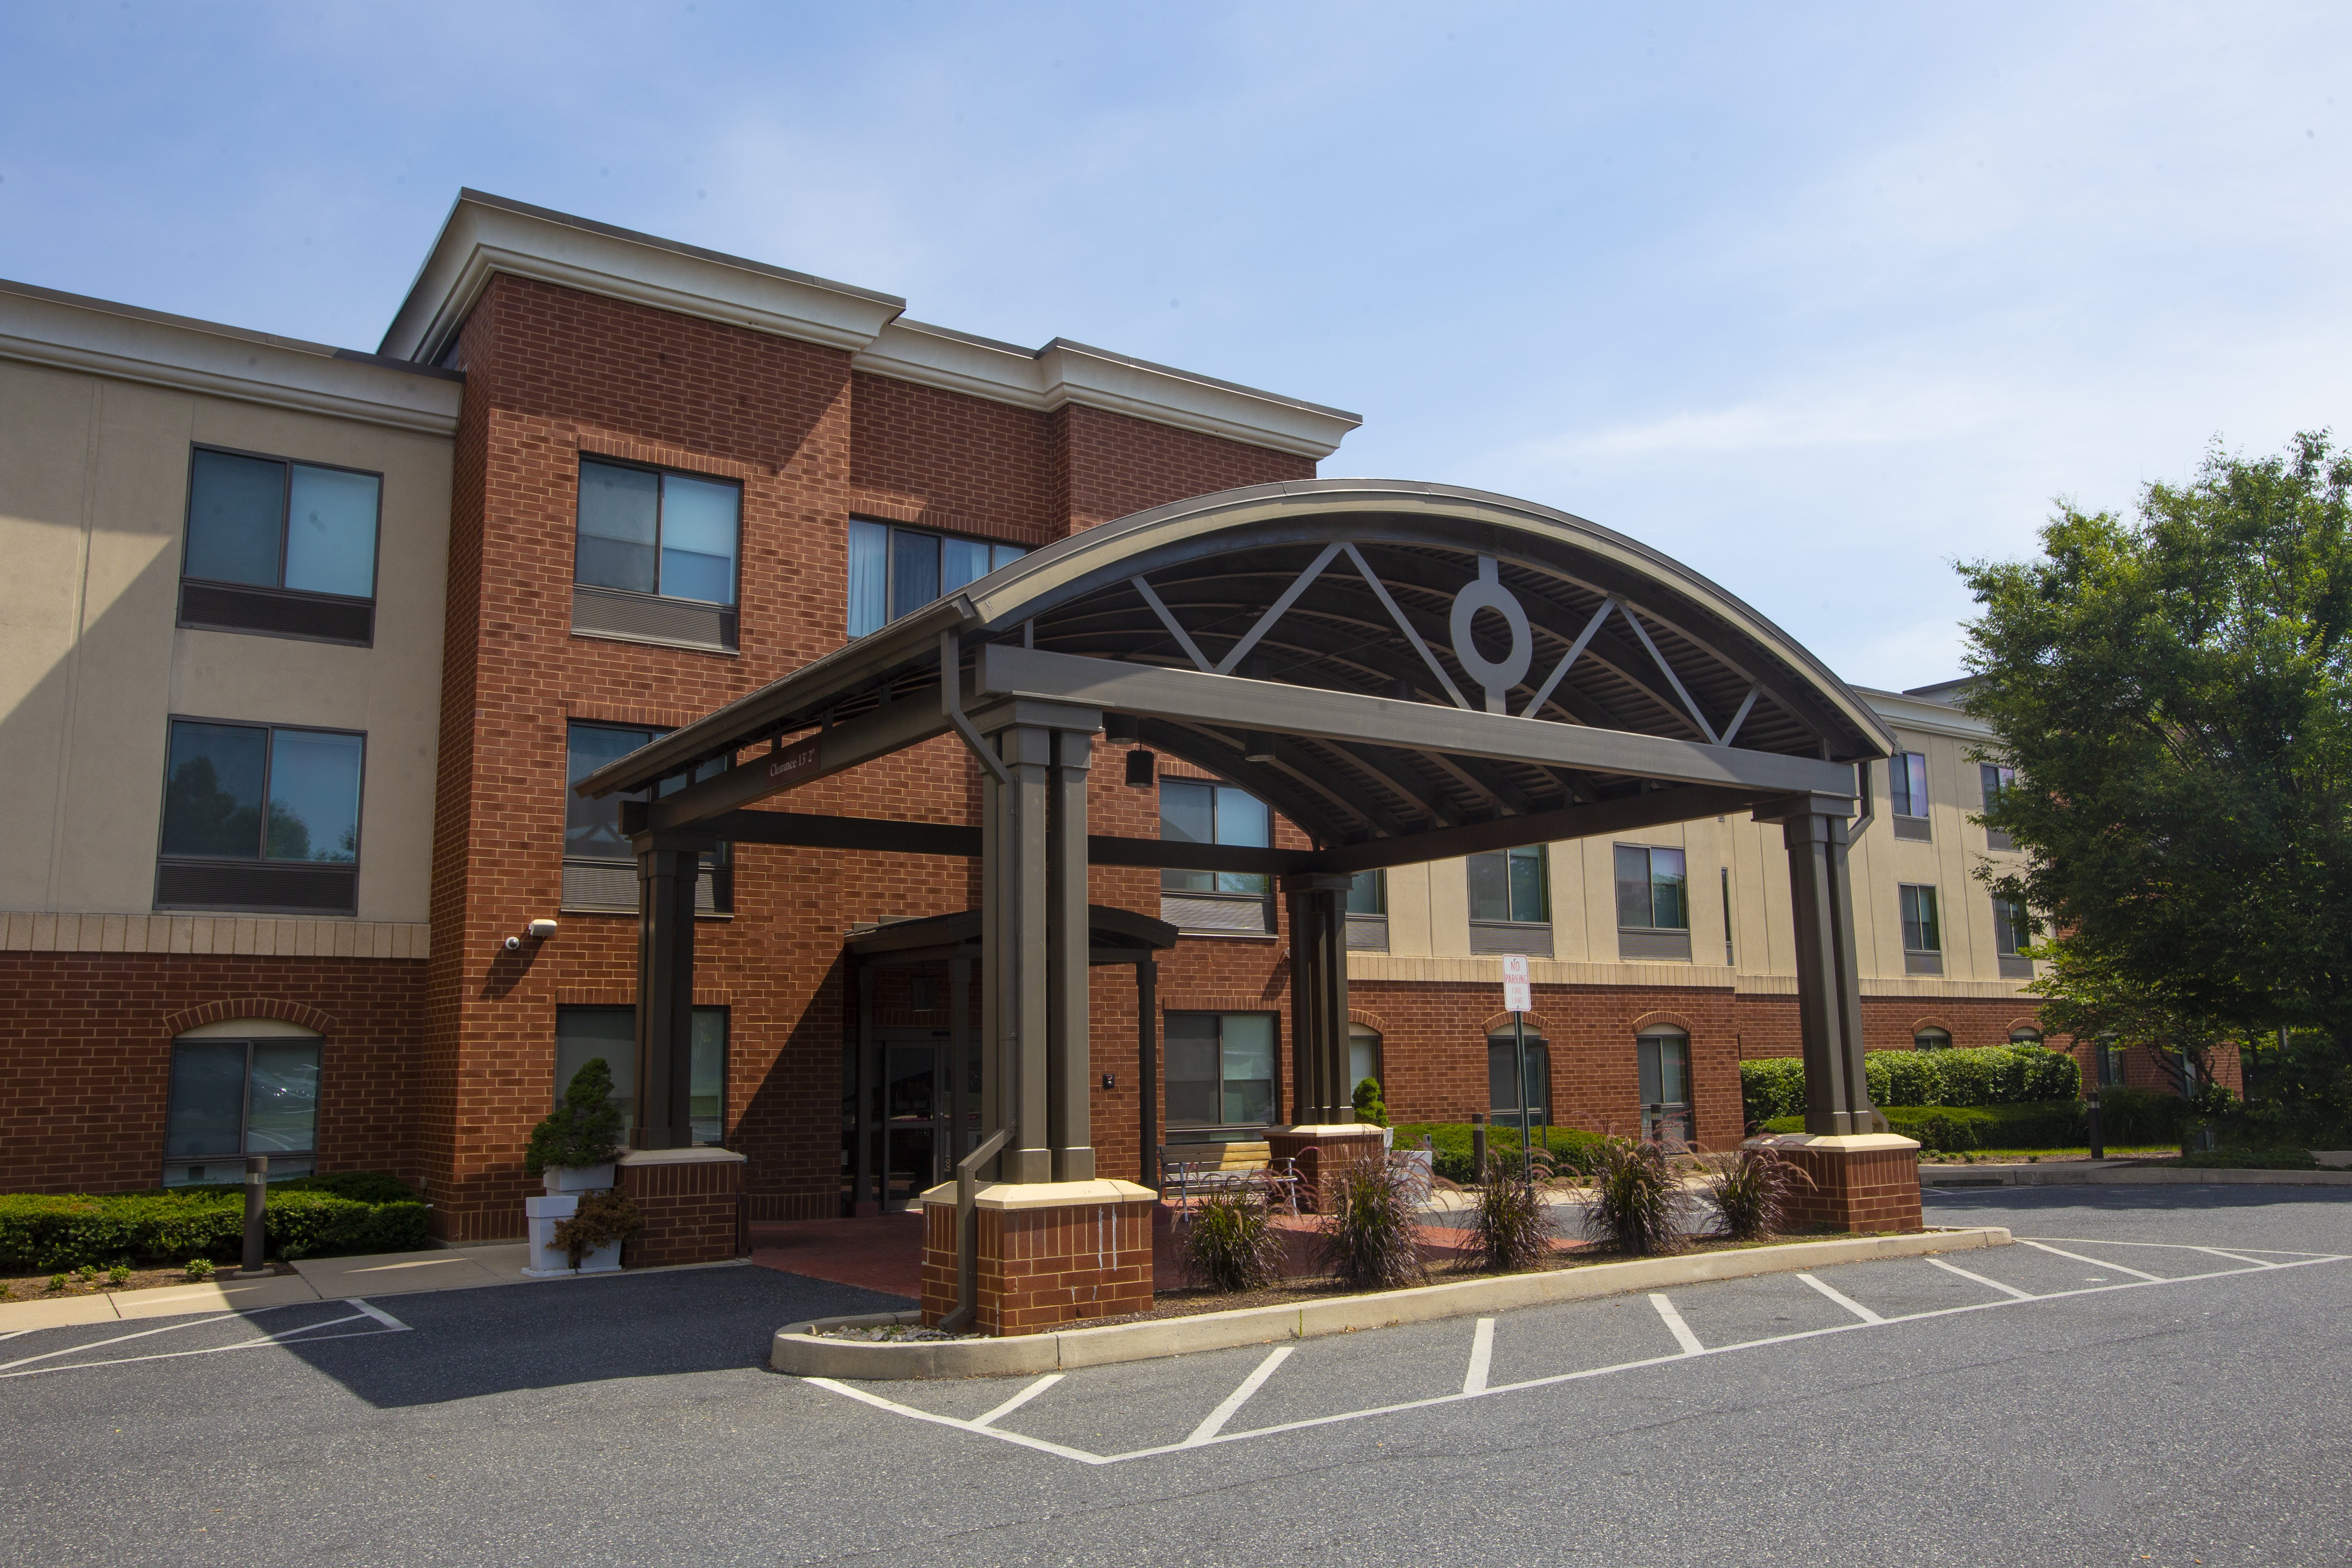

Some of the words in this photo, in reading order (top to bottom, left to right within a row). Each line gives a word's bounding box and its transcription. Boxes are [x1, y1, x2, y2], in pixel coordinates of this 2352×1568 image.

[770, 760, 796, 777] Clearance
[799, 751, 807, 766] 13'
[1511, 961, 1520, 971] NO
[1505, 974, 1528, 985] PARKING
